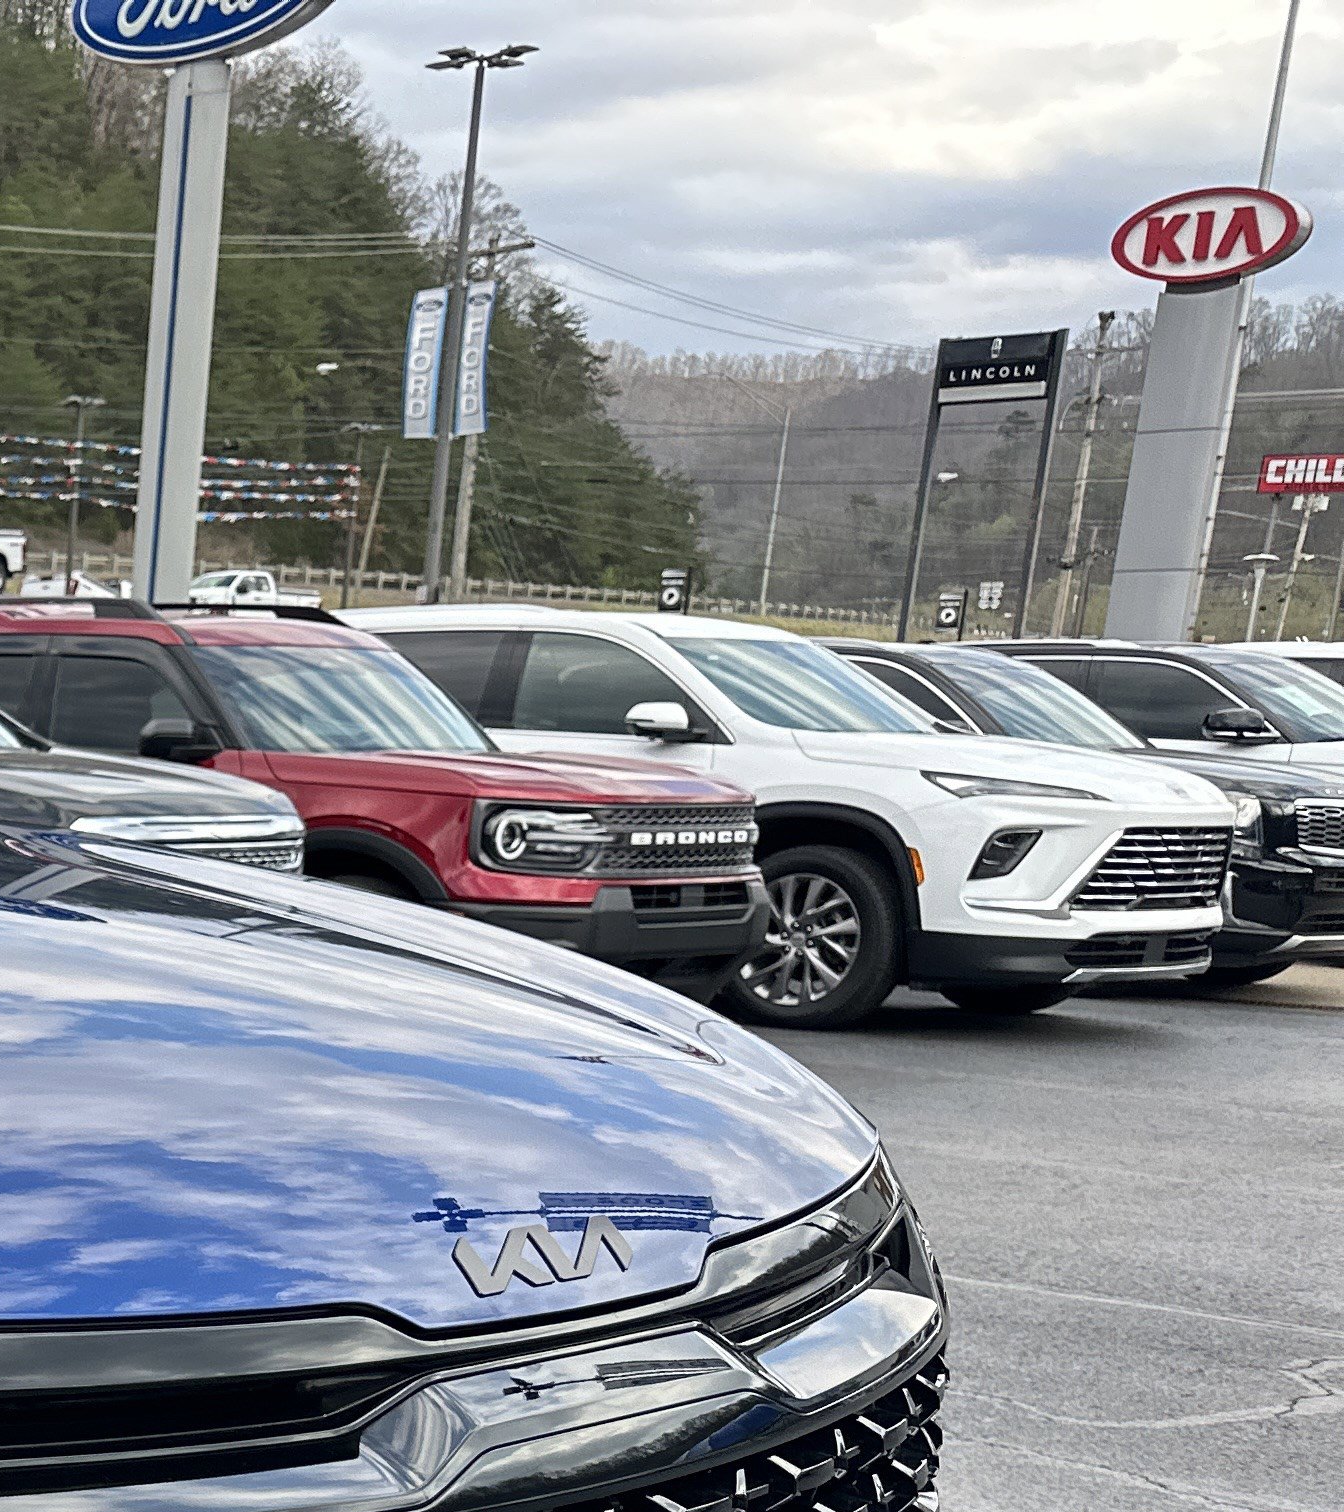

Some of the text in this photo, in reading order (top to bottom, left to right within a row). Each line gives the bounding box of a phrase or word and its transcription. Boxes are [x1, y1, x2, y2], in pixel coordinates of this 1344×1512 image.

[1142, 206, 1264, 267] KIA
[406, 321, 437, 420] FORD
[461, 318, 485, 417] FORD
[948, 364, 1037, 382] LINCOLN
[630, 830, 749, 846] BRONCO
[451, 1215, 634, 1298] KIA
